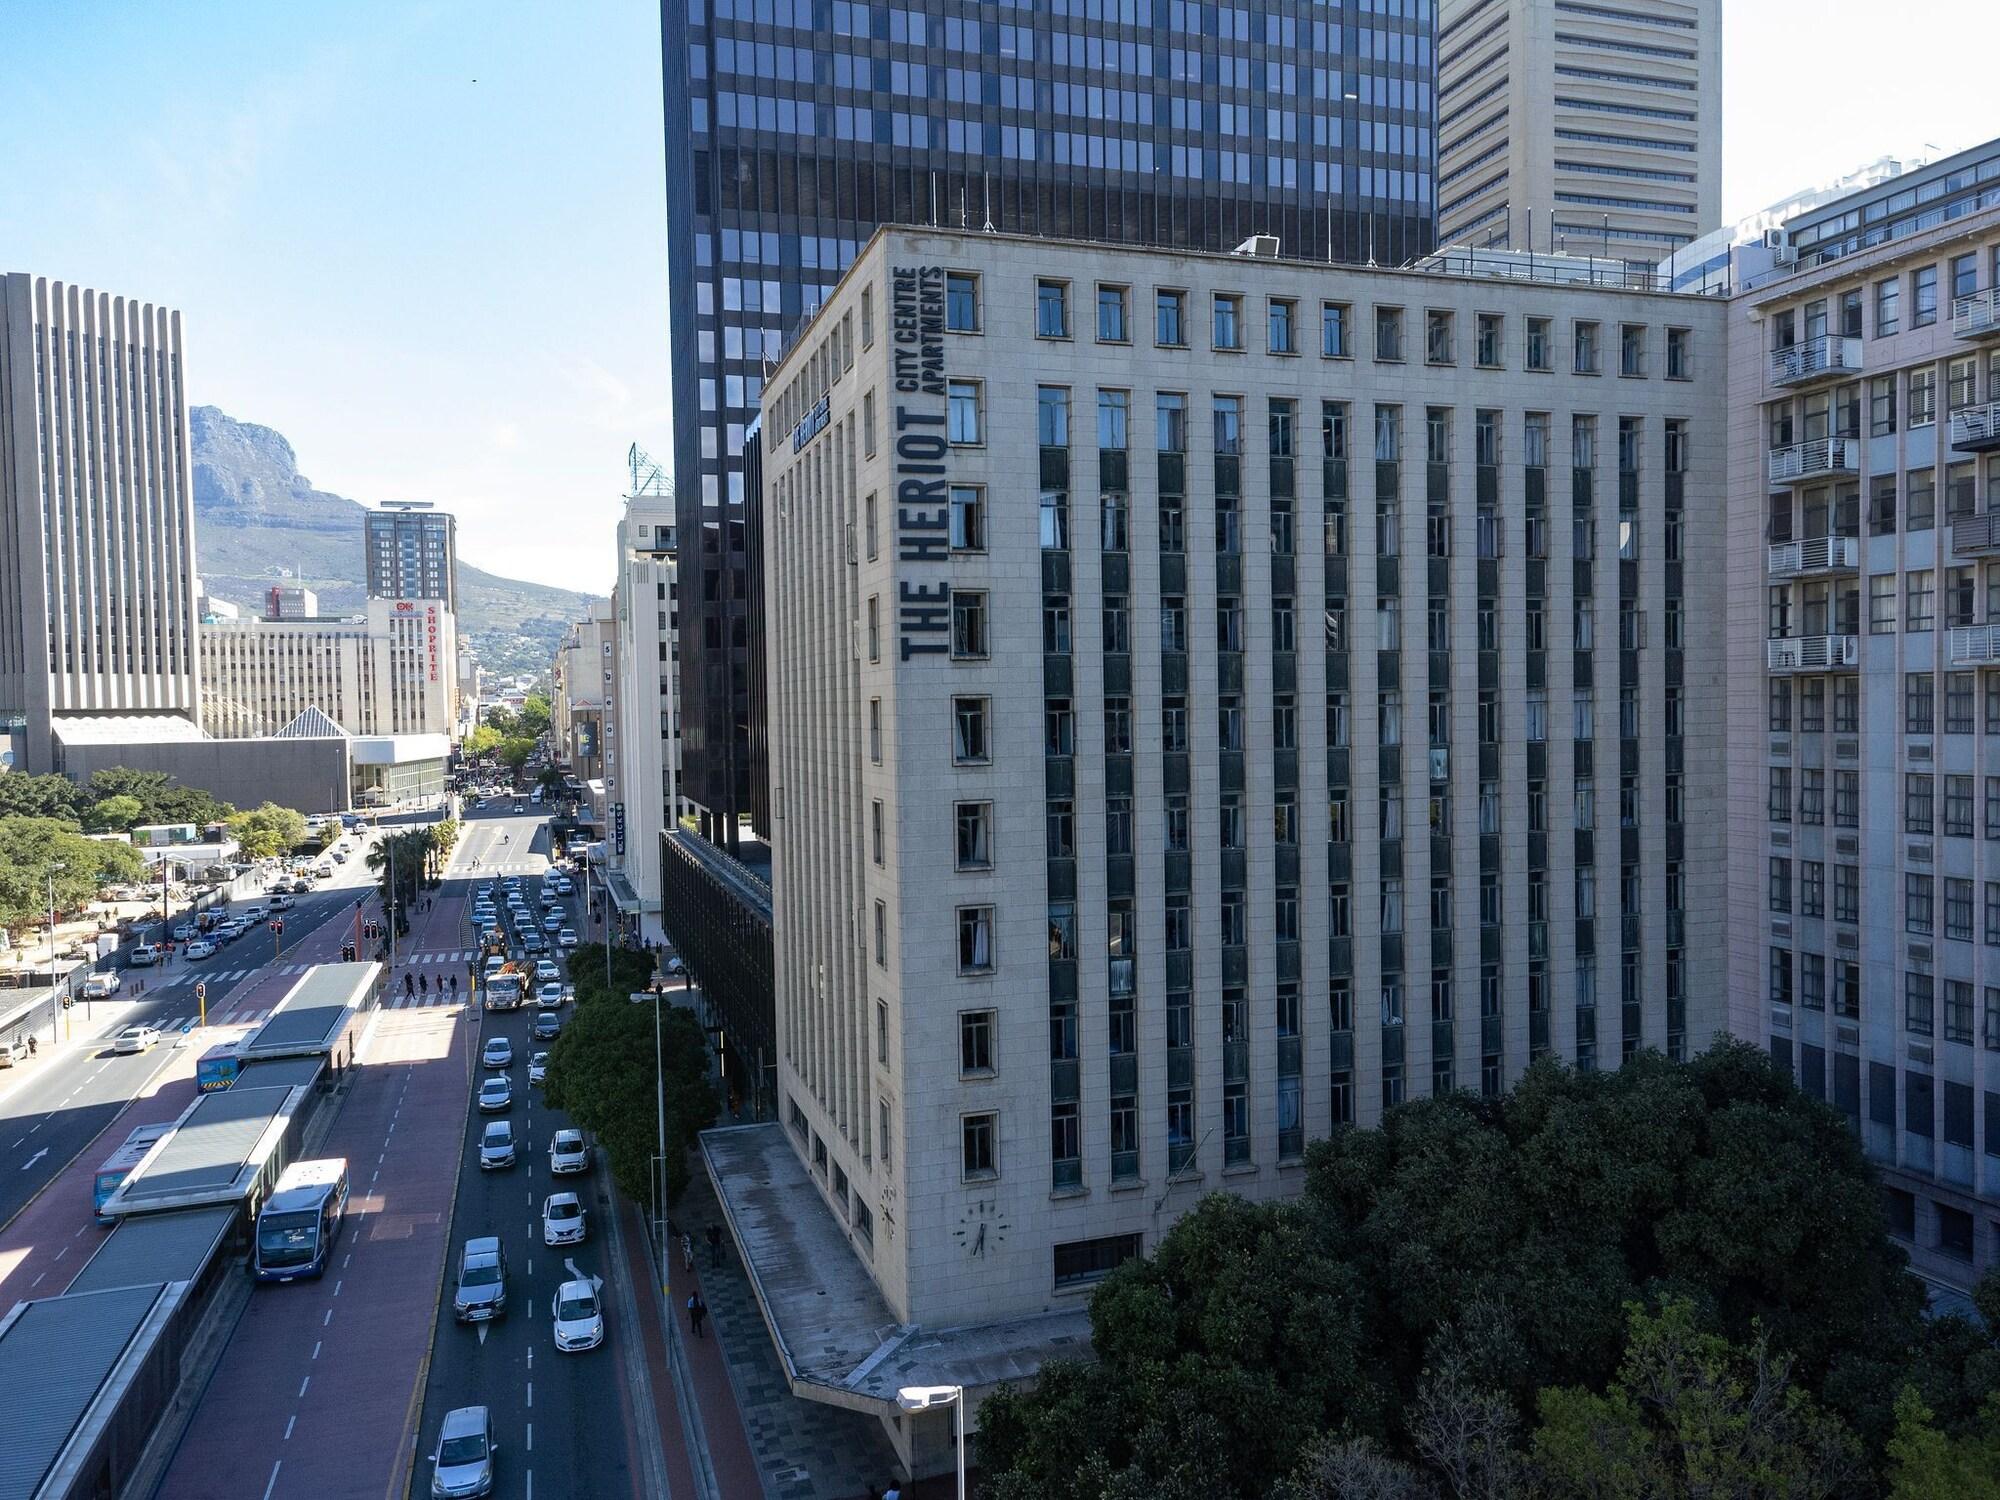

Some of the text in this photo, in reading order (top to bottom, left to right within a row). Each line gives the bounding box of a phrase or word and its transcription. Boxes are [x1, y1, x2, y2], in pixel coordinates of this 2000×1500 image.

[893, 266, 919, 393] CITY CENTRE
[919, 265, 945, 396] APARTMENTS
[897, 406, 948, 662] THE HERIOT
[427, 606, 438, 681] SHOPRITE
[616, 811, 624, 848] CLICKS
